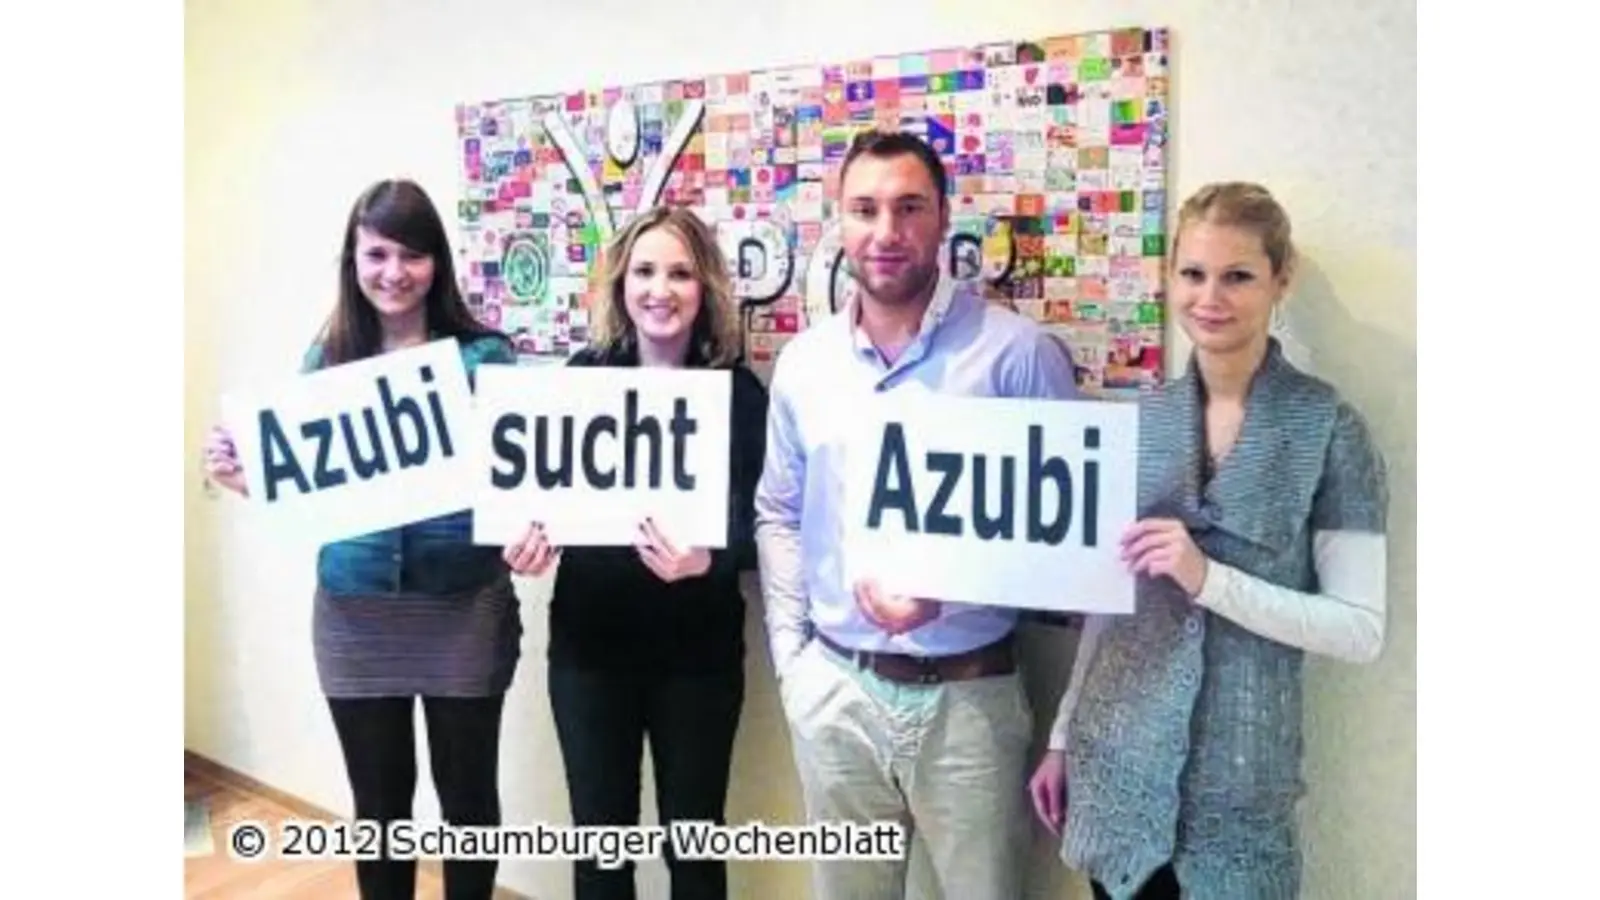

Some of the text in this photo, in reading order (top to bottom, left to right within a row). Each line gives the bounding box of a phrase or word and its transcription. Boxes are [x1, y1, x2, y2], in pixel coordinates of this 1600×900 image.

[260, 366, 454, 501] Azubi
[491, 390, 698, 490] sucht
[867, 421, 1101, 547] Azubi
